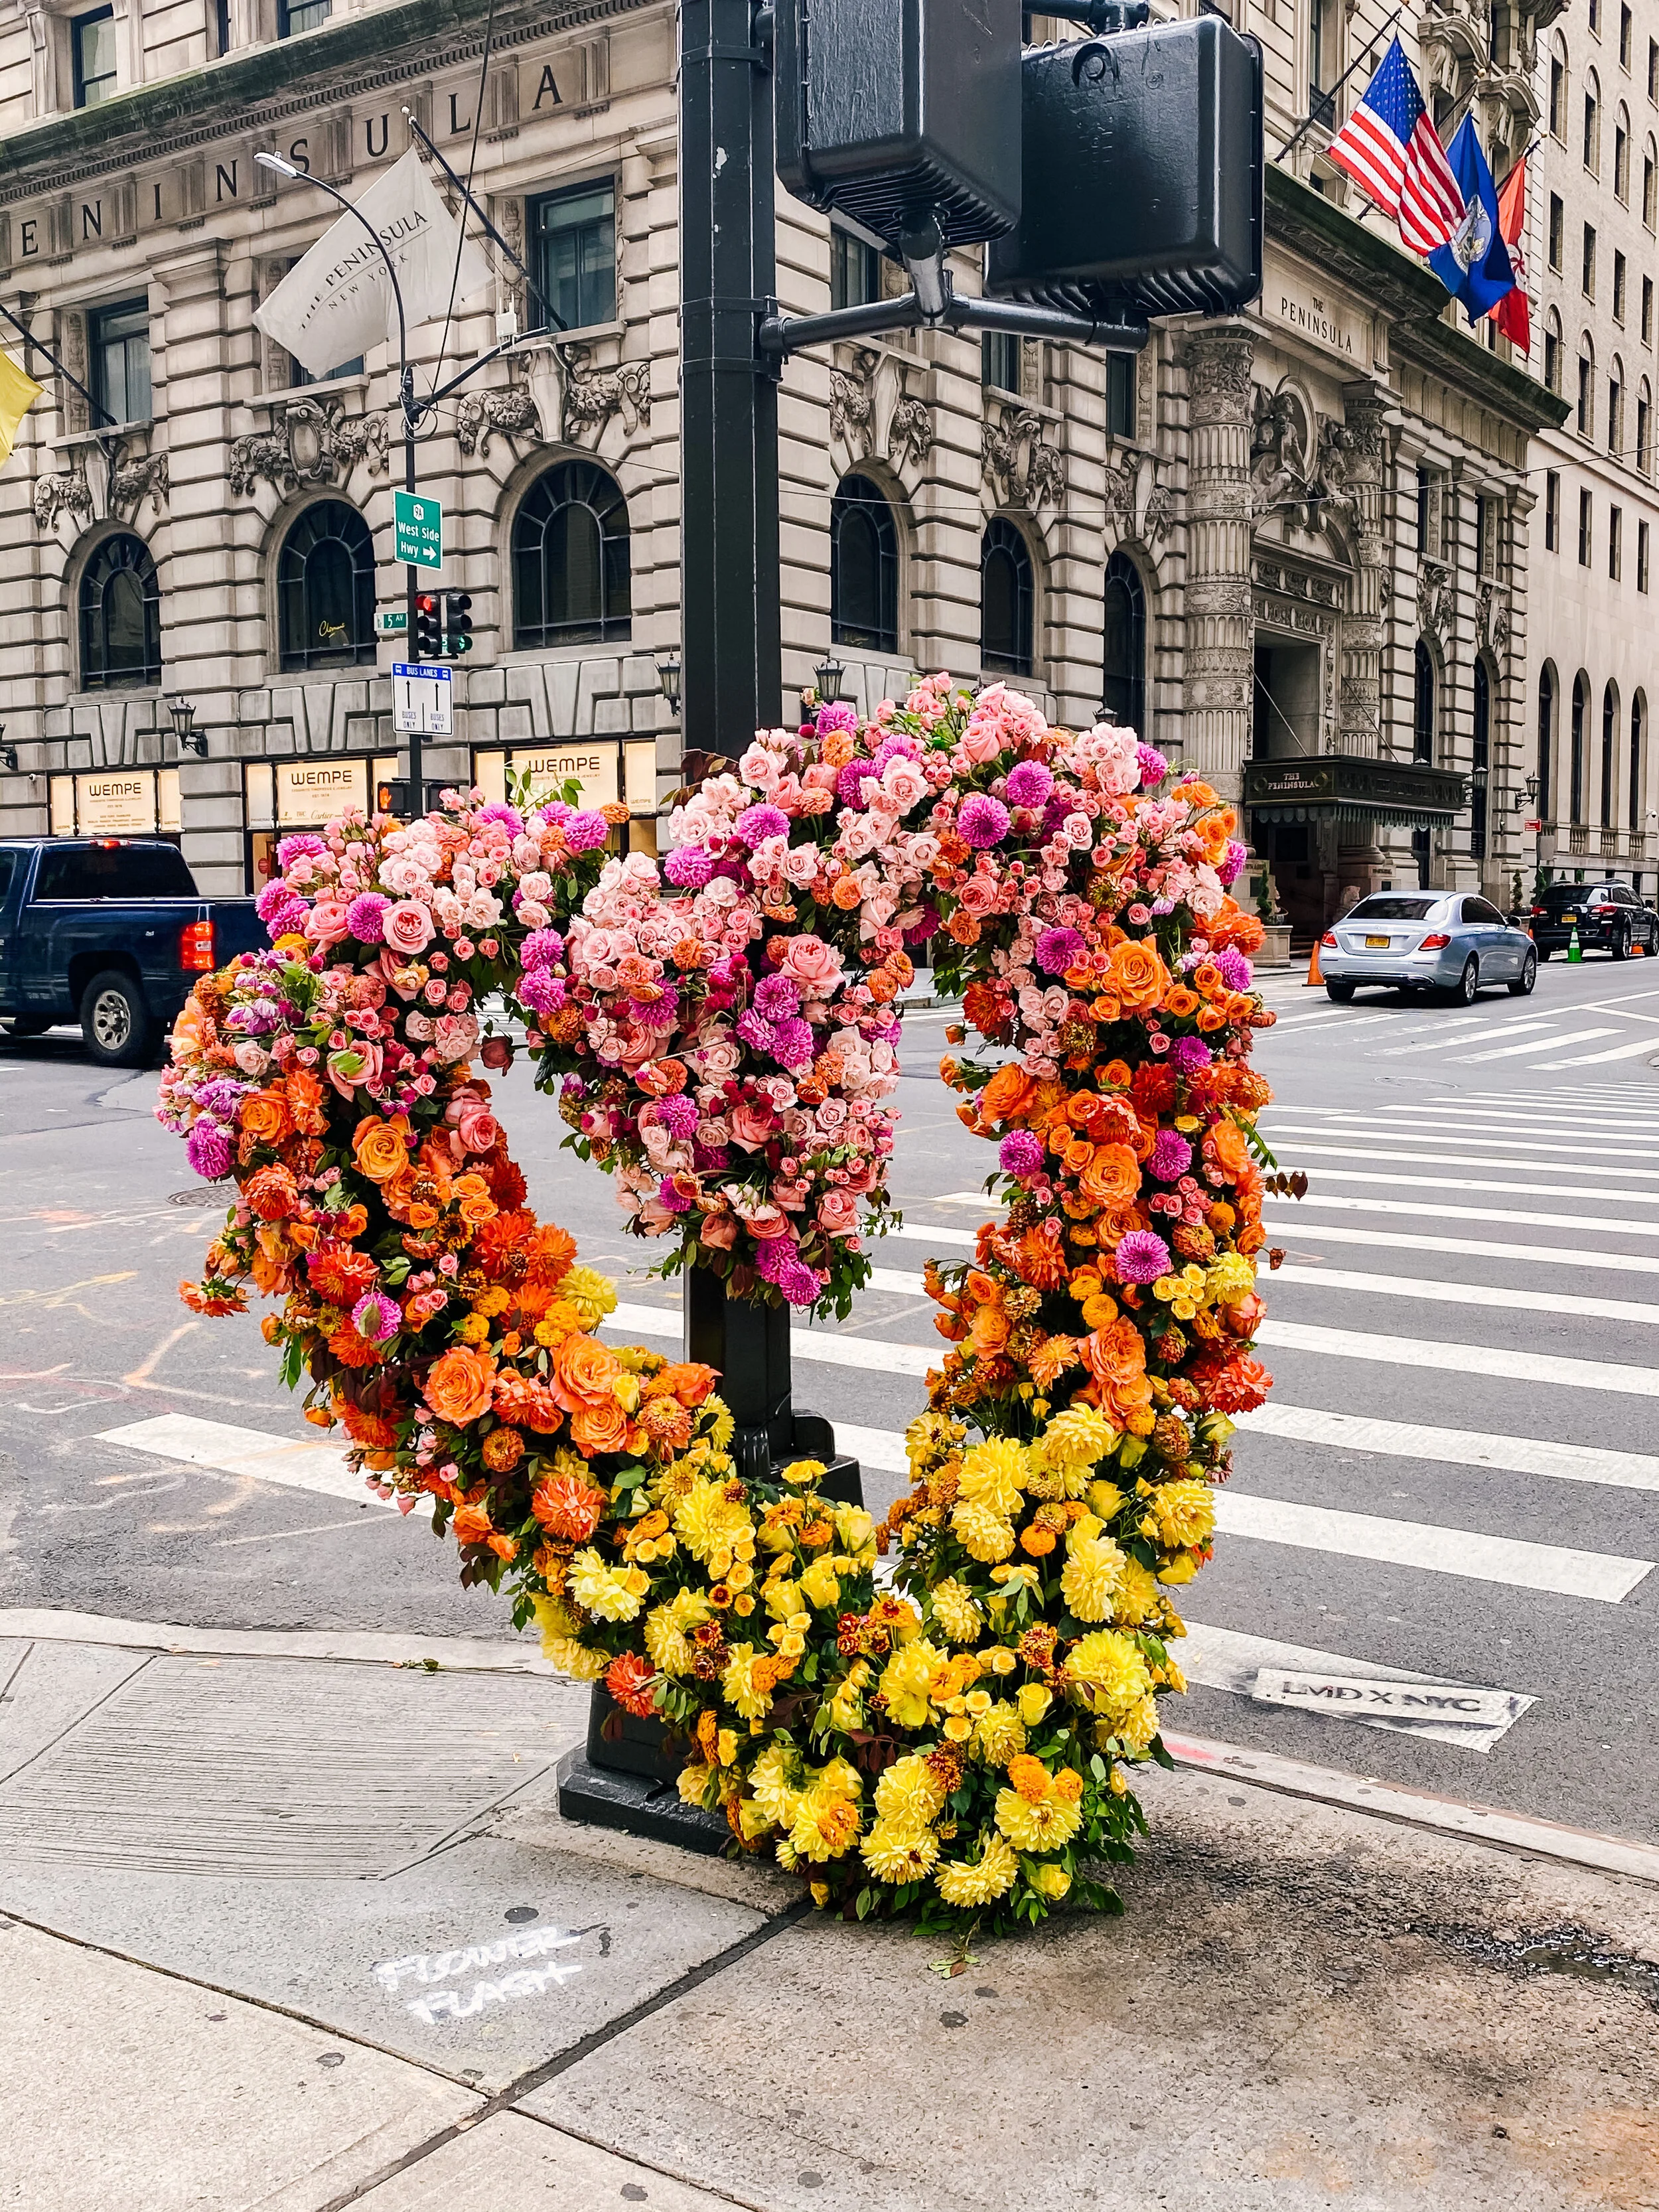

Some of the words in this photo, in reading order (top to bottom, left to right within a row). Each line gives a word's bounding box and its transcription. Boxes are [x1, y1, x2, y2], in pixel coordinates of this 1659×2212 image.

[325, 210, 428, 287] PENINSULA
[328, 283, 360, 310] NEW
[368, 253, 409, 282] YORK
[1312, 297, 1324, 313] THE
[1281, 297, 1352, 354] PENINSULA
[415, 506, 423, 519] 9A
[398, 521, 419, 537] West
[421, 527, 439, 542] Side
[401, 541, 419, 558] Hwy
[388, 615, 393, 628] 5
[406, 666, 418, 675] BUS
[419, 668, 437, 678] LANES
[529, 757, 600, 773] WEMPE
[291, 770, 352, 784] WEMPE
[1283, 772, 1300, 780] THE
[89, 782, 141, 796] WEMPE
[1267, 780, 1315, 790] PENINSULA
[311, 810, 333, 820] Cartier
[1282, 1680, 1362, 1700] LMD
[1369, 1689, 1392, 1705] X
[1402, 1694, 1481, 1712] NYC
[375, 1926, 582, 1991] FLOWER
